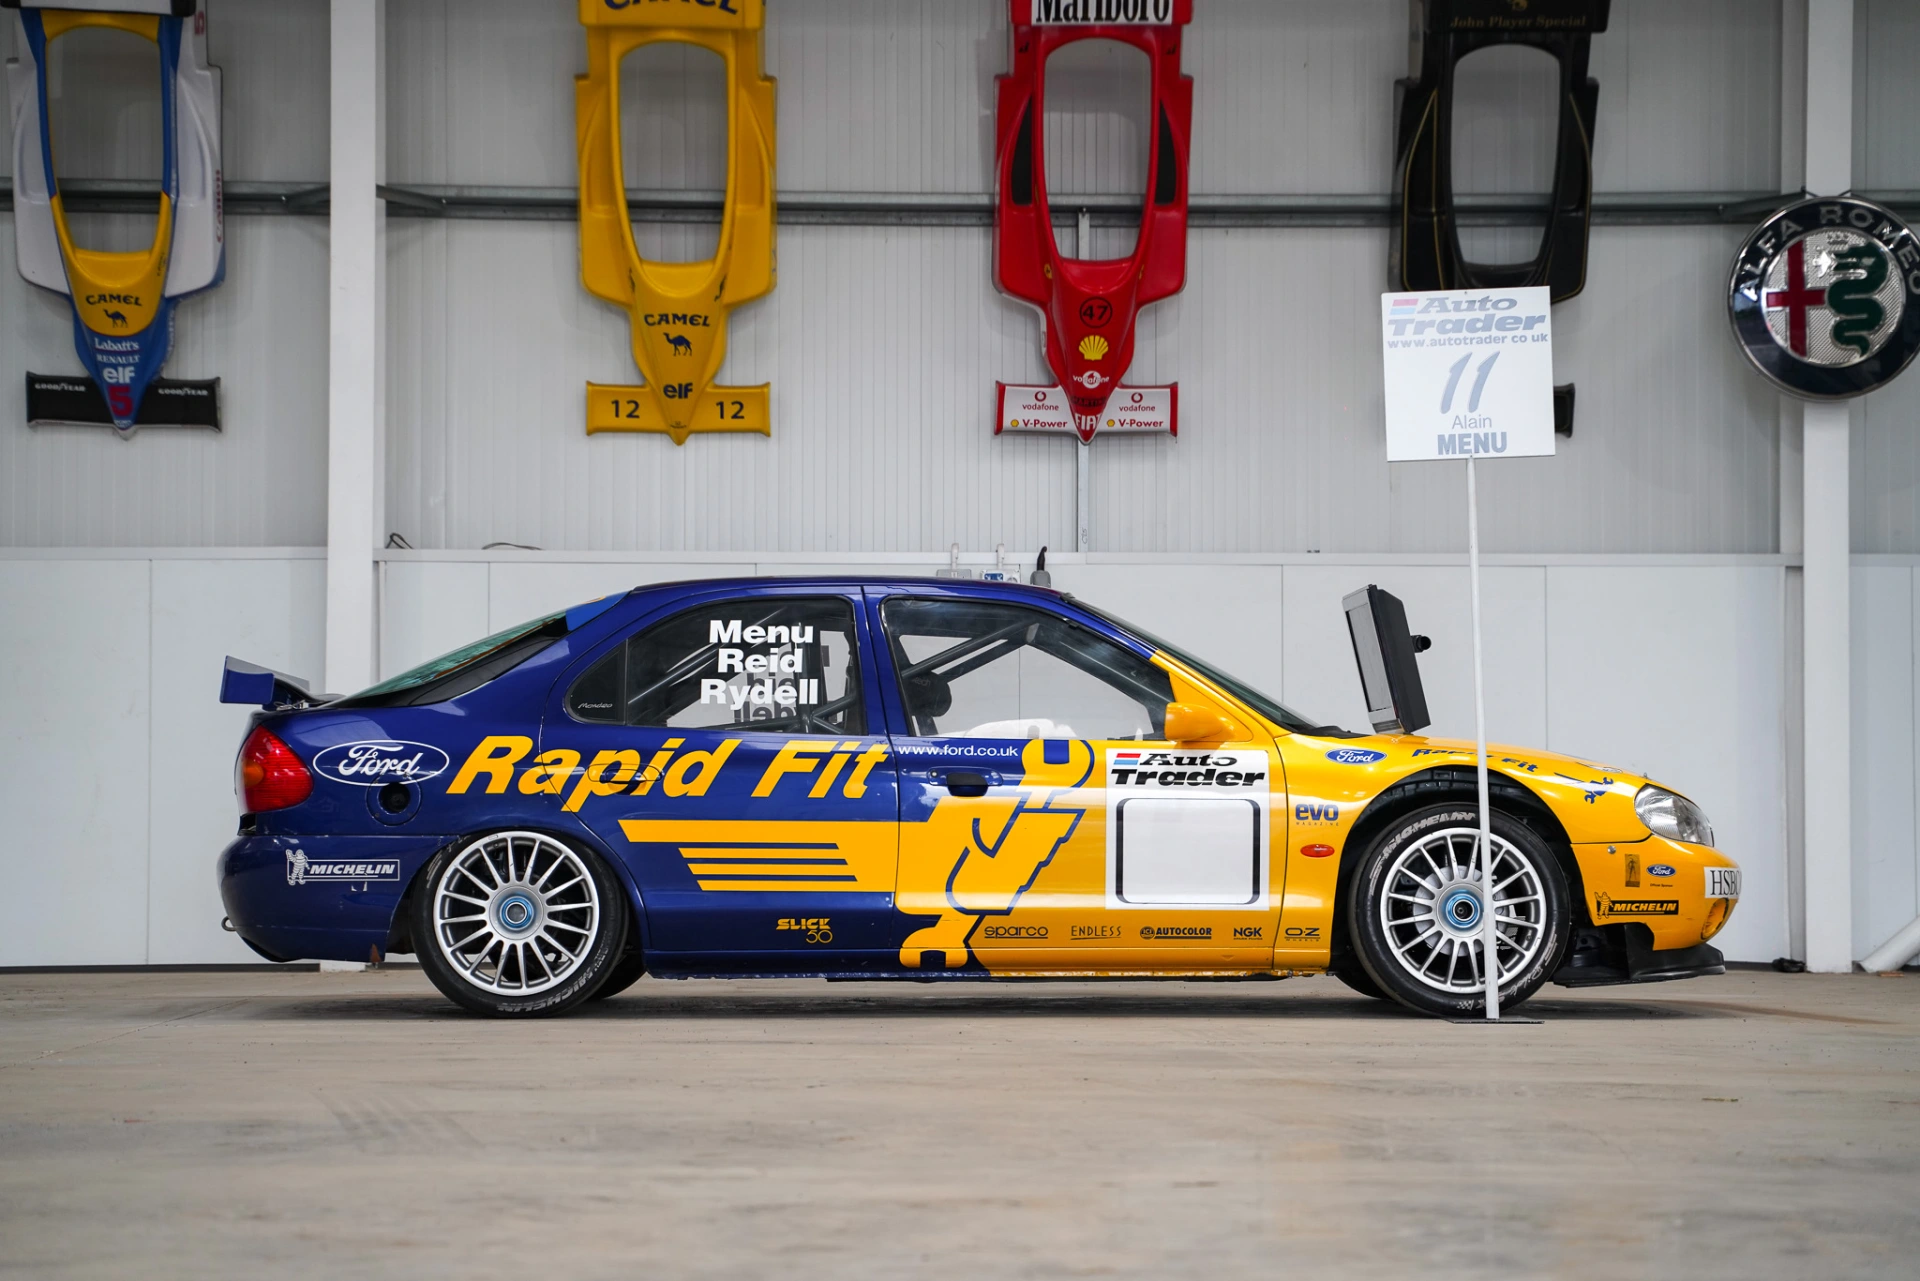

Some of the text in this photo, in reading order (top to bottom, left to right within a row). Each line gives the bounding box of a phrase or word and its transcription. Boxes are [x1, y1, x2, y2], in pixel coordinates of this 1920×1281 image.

[1452, 15, 1586, 29] John Player Special
[1740, 219, 1803, 301] ALFA
[85, 294, 142, 306] CAMEL
[1417, 296, 1518, 314] Auto
[1083, 305, 1109, 320] 47
[644, 313, 710, 327] CAMEL
[1388, 314, 1547, 336] Trader
[95, 337, 139, 351] Labatt's
[97, 354, 140, 364] RENAULT
[103, 366, 135, 383] elf
[1073, 374, 1110, 386] vodafone
[1440, 350, 1501, 414] 11
[663, 383, 693, 399] elf
[109, 386, 134, 417] 5
[611, 400, 640, 418] 12
[716, 401, 745, 420] 12
[1022, 419, 1068, 428] V-Power
[1118, 419, 1164, 428] V-Power
[1452, 415, 1492, 429] Alain
[1437, 432, 1508, 455] MENU
[710, 620, 813, 643] Menu
[718, 648, 803, 673] Reid
[701, 679, 818, 710] Rydell
[899, 744, 1018, 756] www.ford.co.uk
[338, 745, 423, 776] Ford
[1140, 753, 1237, 767] Auto
[446, 736, 889, 812] Rapid Fit
[1111, 769, 1265, 786] Trader
[1295, 804, 1339, 821] evo
[310, 864, 395, 875] MICHELIN
[1613, 903, 1677, 911] MICHELIN
[776, 918, 831, 930] SLICK
[1071, 925, 1121, 937] ENDLESS
[806, 929, 833, 943] 50
[984, 926, 1048, 939] sparco
[1156, 927, 1212, 936] AUTOCOLOR
[1234, 927, 1262, 937] NGK
